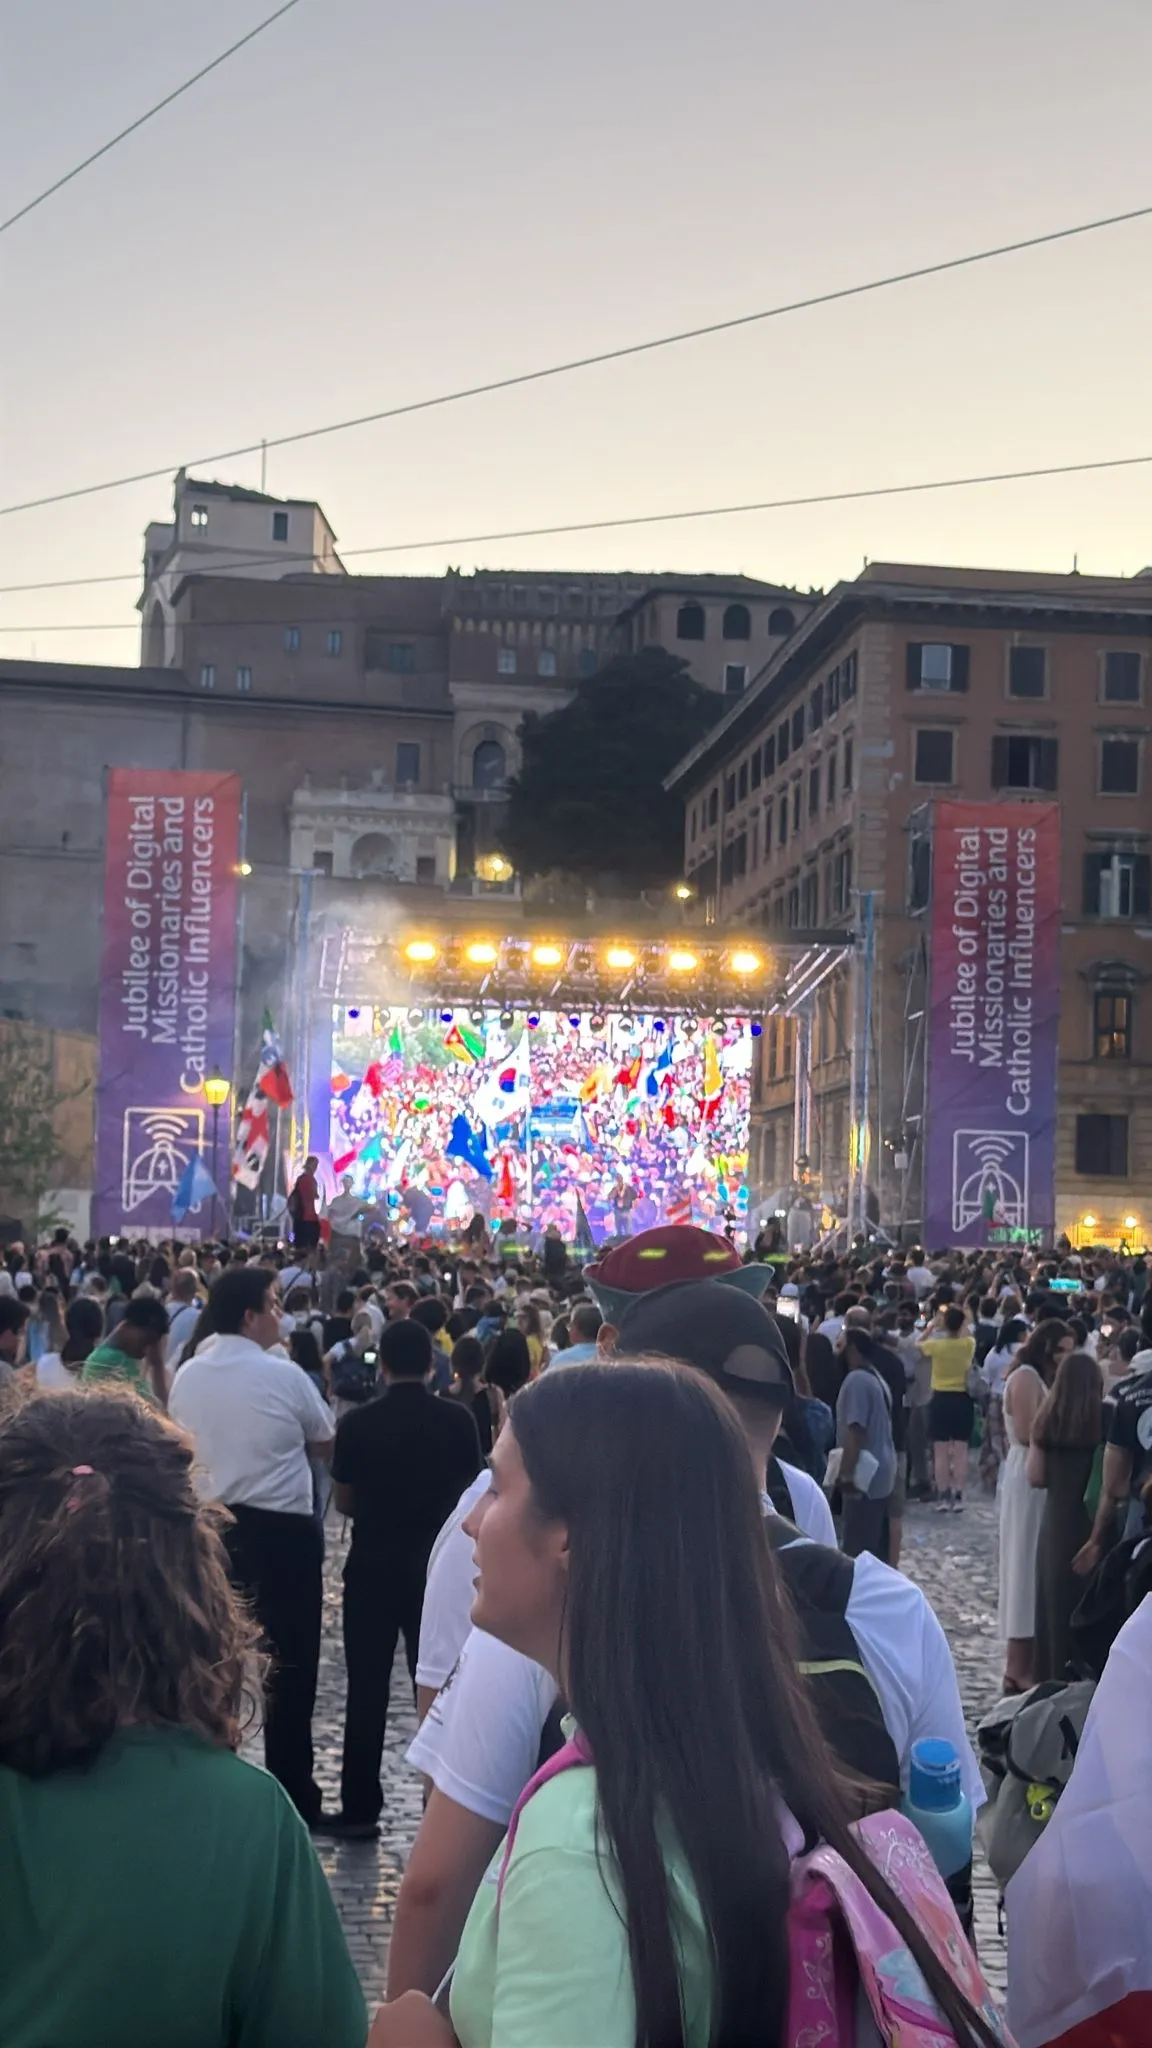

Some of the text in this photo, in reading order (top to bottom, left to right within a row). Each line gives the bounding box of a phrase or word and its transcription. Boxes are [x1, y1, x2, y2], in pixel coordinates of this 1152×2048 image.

[121, 796, 162, 1039] Jubilee of Digital
[152, 797, 184, 1044] Missionaries and
[180, 797, 214, 1094] Catholic Influencers
[950, 826, 987, 1063] Jubilee of Digital
[979, 827, 1008, 1068] Missionaries and
[1006, 827, 1036, 1116] Catholic Influencers
